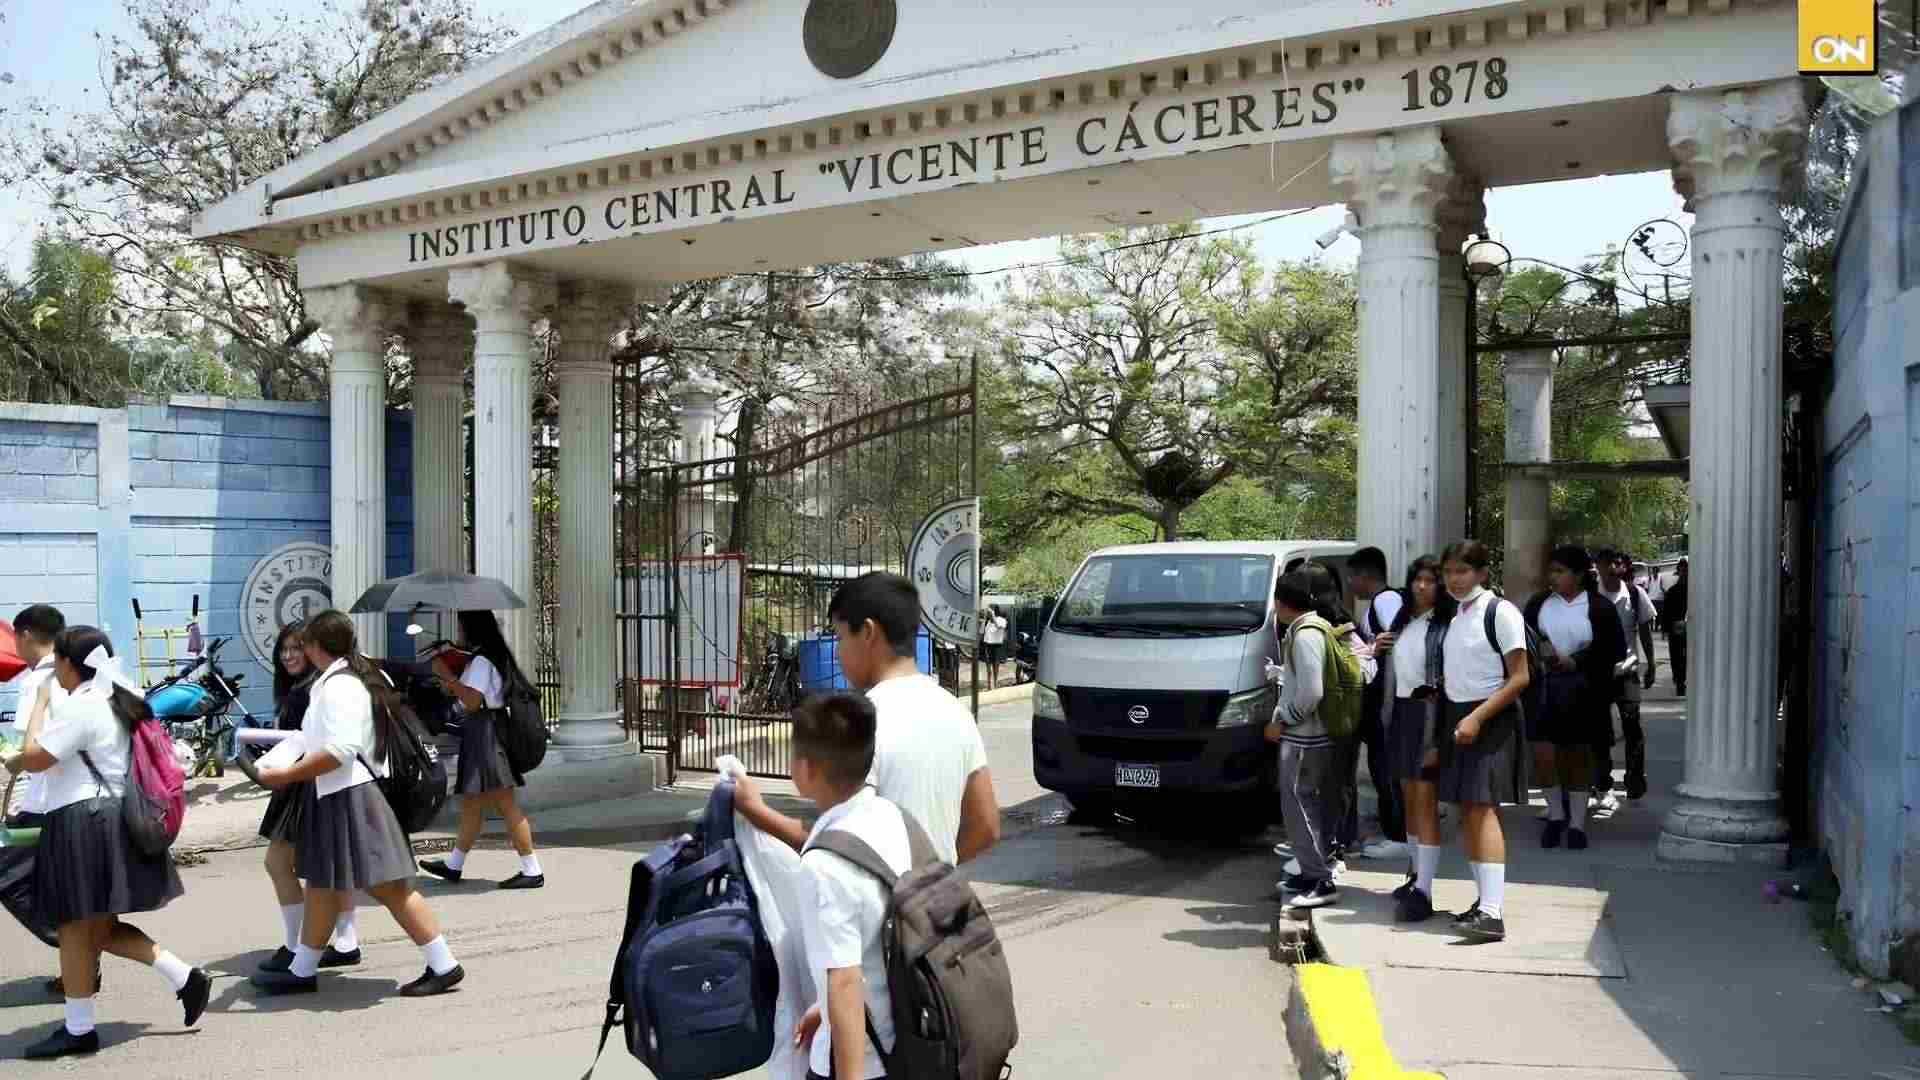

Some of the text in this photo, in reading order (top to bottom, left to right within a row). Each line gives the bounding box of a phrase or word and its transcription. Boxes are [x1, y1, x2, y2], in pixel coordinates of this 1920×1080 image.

[409, 205, 586, 262] INSTITUTO
[604, 169, 795, 230] CENTRAL
[819, 127, 1048, 193] "VICENTE
[1401, 57, 1509, 112] 1878
